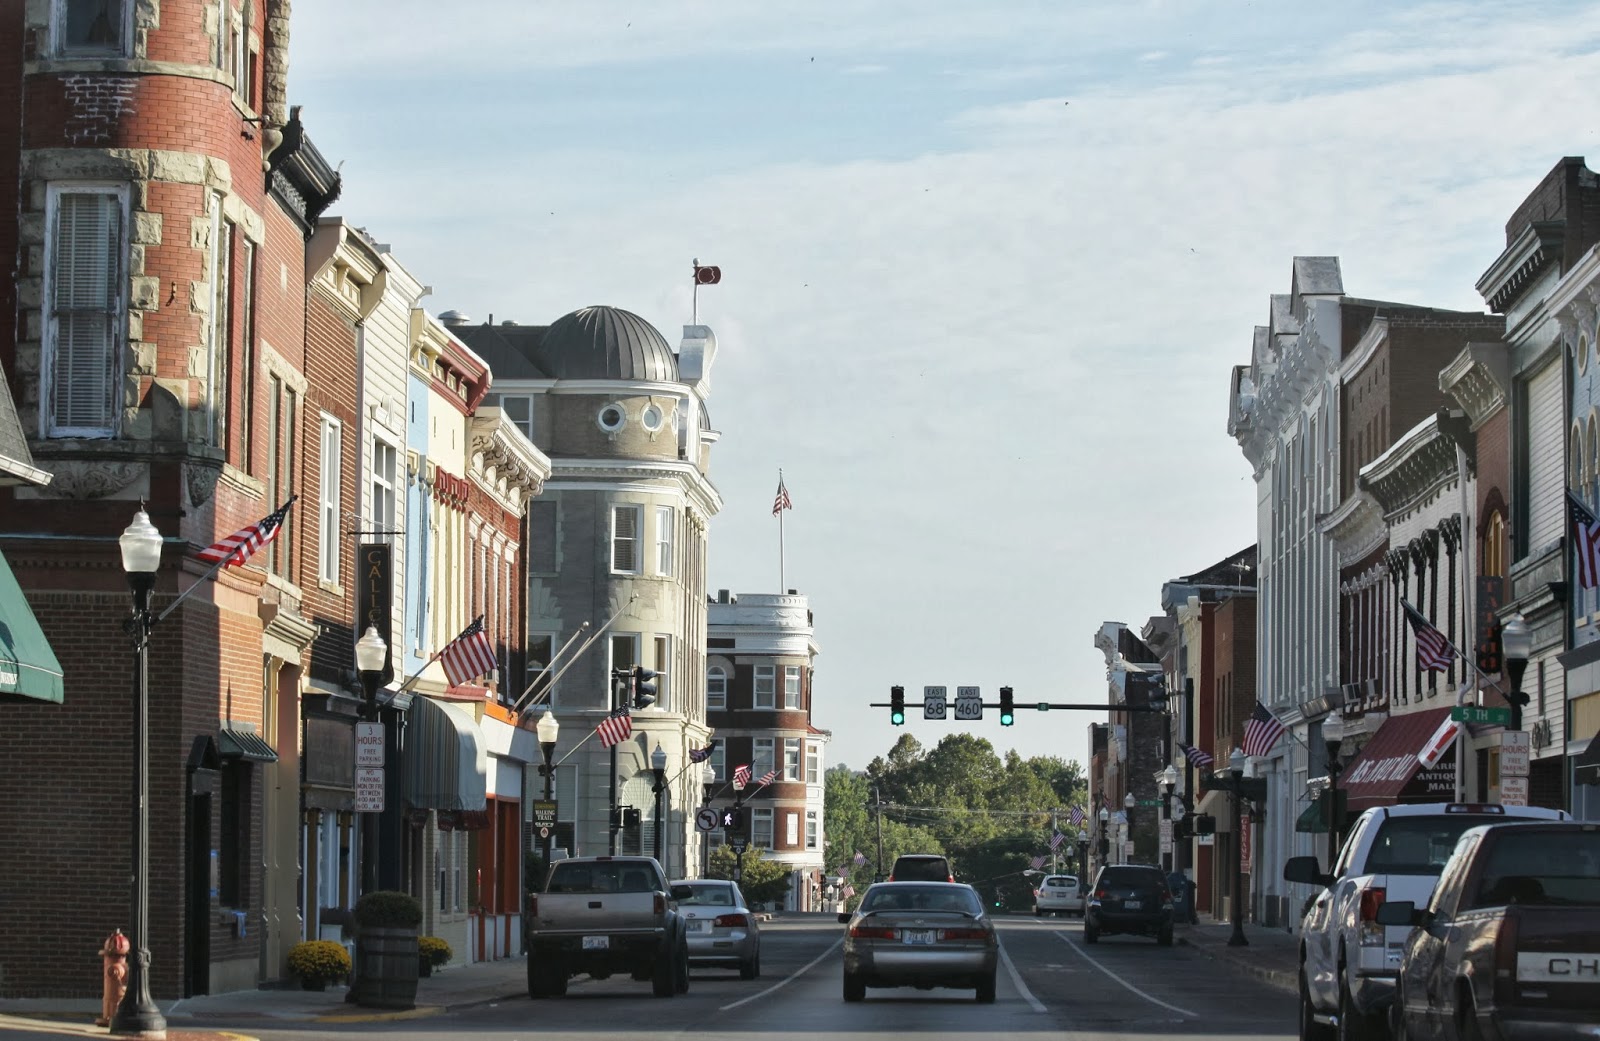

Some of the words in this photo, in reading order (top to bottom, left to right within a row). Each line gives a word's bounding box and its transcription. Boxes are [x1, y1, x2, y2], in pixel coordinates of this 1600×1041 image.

[927, 688, 943, 696] EAST
[960, 688, 977, 696] EAST
[926, 702, 944, 715] 68
[957, 702, 980, 715] 460
[1462, 708, 1470, 720] 5
[1475, 709, 1489, 720] TH
[368, 725, 373, 736] 3
[357, 736, 383, 745] HOURS
[1512, 733, 1518, 744] 3
[1502, 745, 1528, 754] HOURS
[1417, 772, 1457, 782] ANTIQU
[1426, 782, 1456, 793] MALL
[1549, 958, 1599, 976] CH
